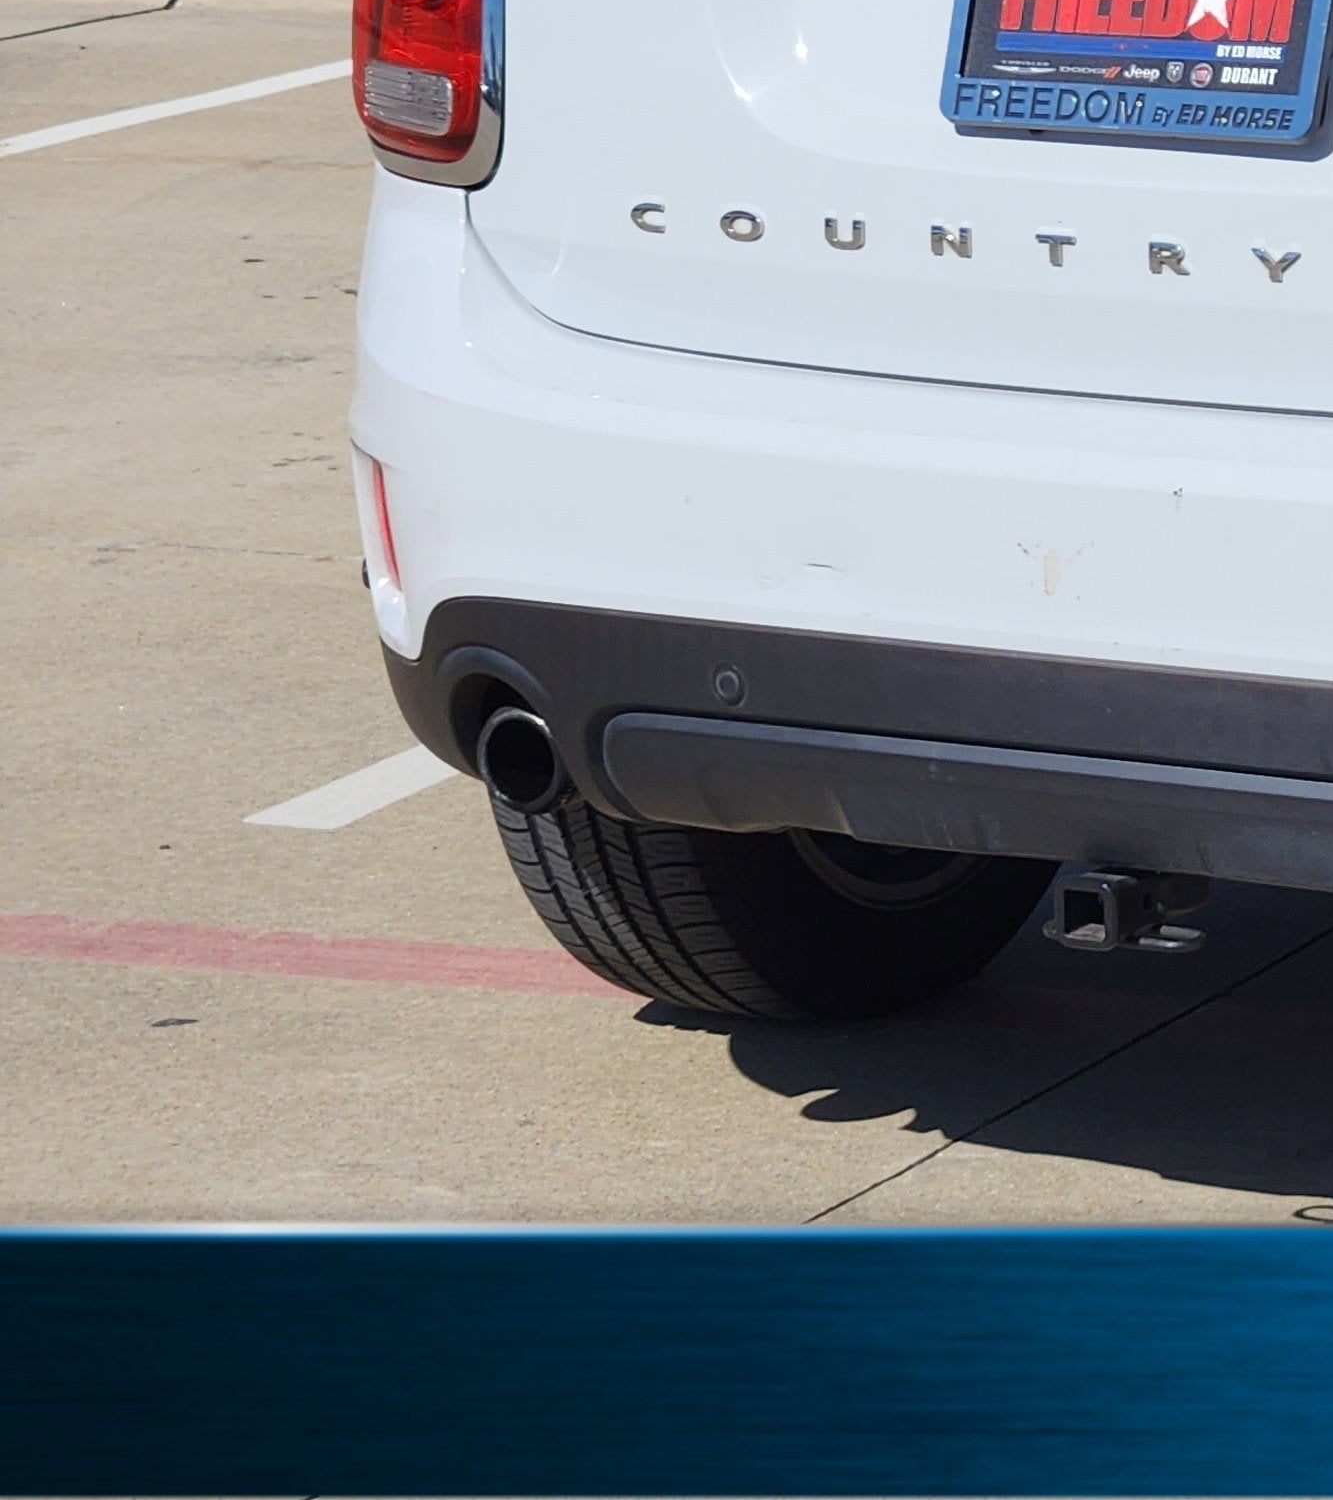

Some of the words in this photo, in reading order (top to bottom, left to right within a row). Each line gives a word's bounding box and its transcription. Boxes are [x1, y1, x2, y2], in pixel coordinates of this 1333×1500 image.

[1216, 45, 1232, 57] BY
[1124, 64, 1160, 82] Jeep
[1220, 66, 1278, 85] DURANT
[953, 83, 1147, 125] FREEDOM
[1175, 103, 1207, 125] ED
[1209, 105, 1295, 131] MORSE
